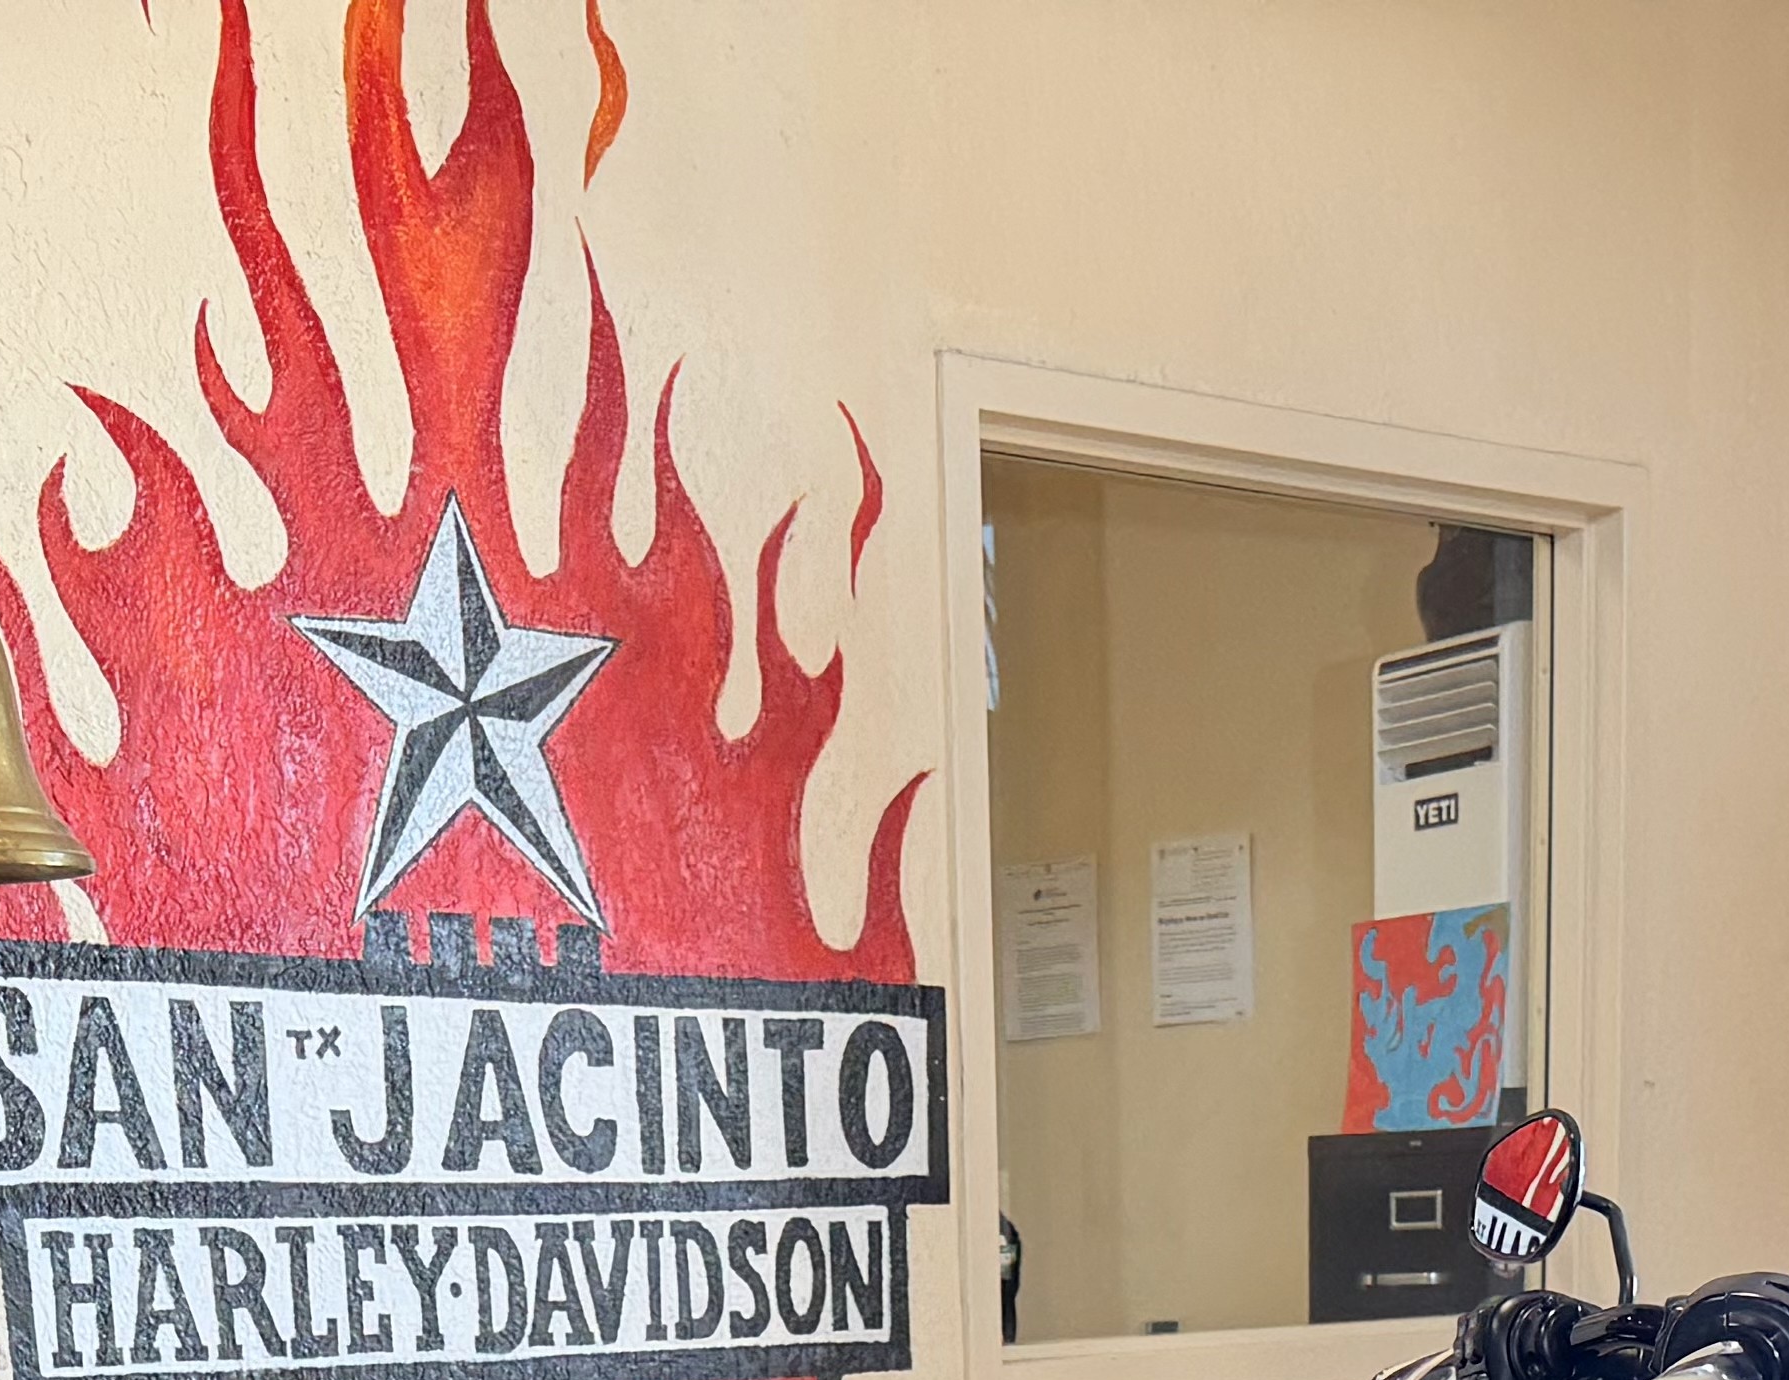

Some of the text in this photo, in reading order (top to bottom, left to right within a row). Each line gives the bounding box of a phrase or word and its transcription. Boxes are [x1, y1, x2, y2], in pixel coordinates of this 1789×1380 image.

[1416, 798, 1456, 826] YETI
[285, 1024, 343, 1060] TX
[329, 1003, 914, 1176] JACINTO
